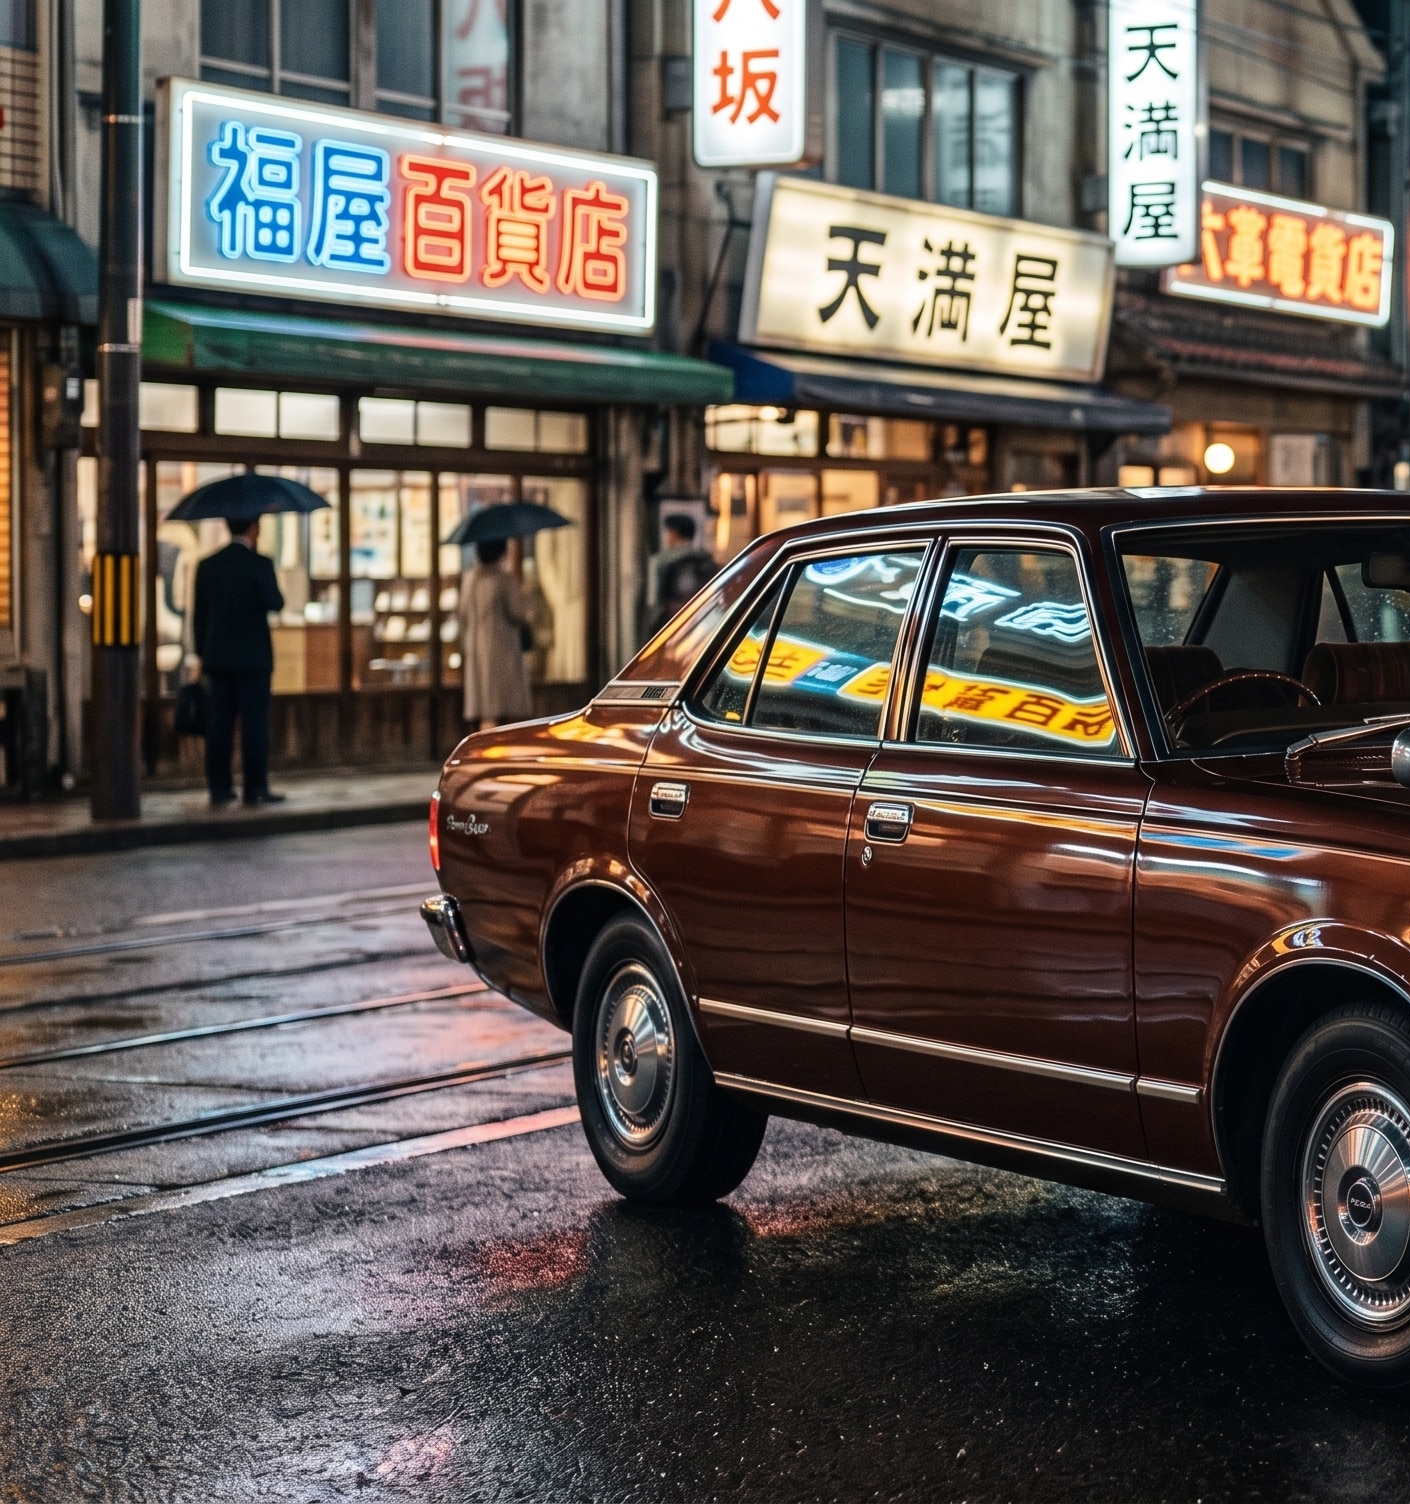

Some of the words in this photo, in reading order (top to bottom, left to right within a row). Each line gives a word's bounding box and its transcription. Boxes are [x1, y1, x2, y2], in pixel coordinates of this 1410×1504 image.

[208, 120, 630, 302] 福屋百貨店
[1123, 24, 1179, 241] 天満屋
[817, 225, 1061, 350] 天満屋
